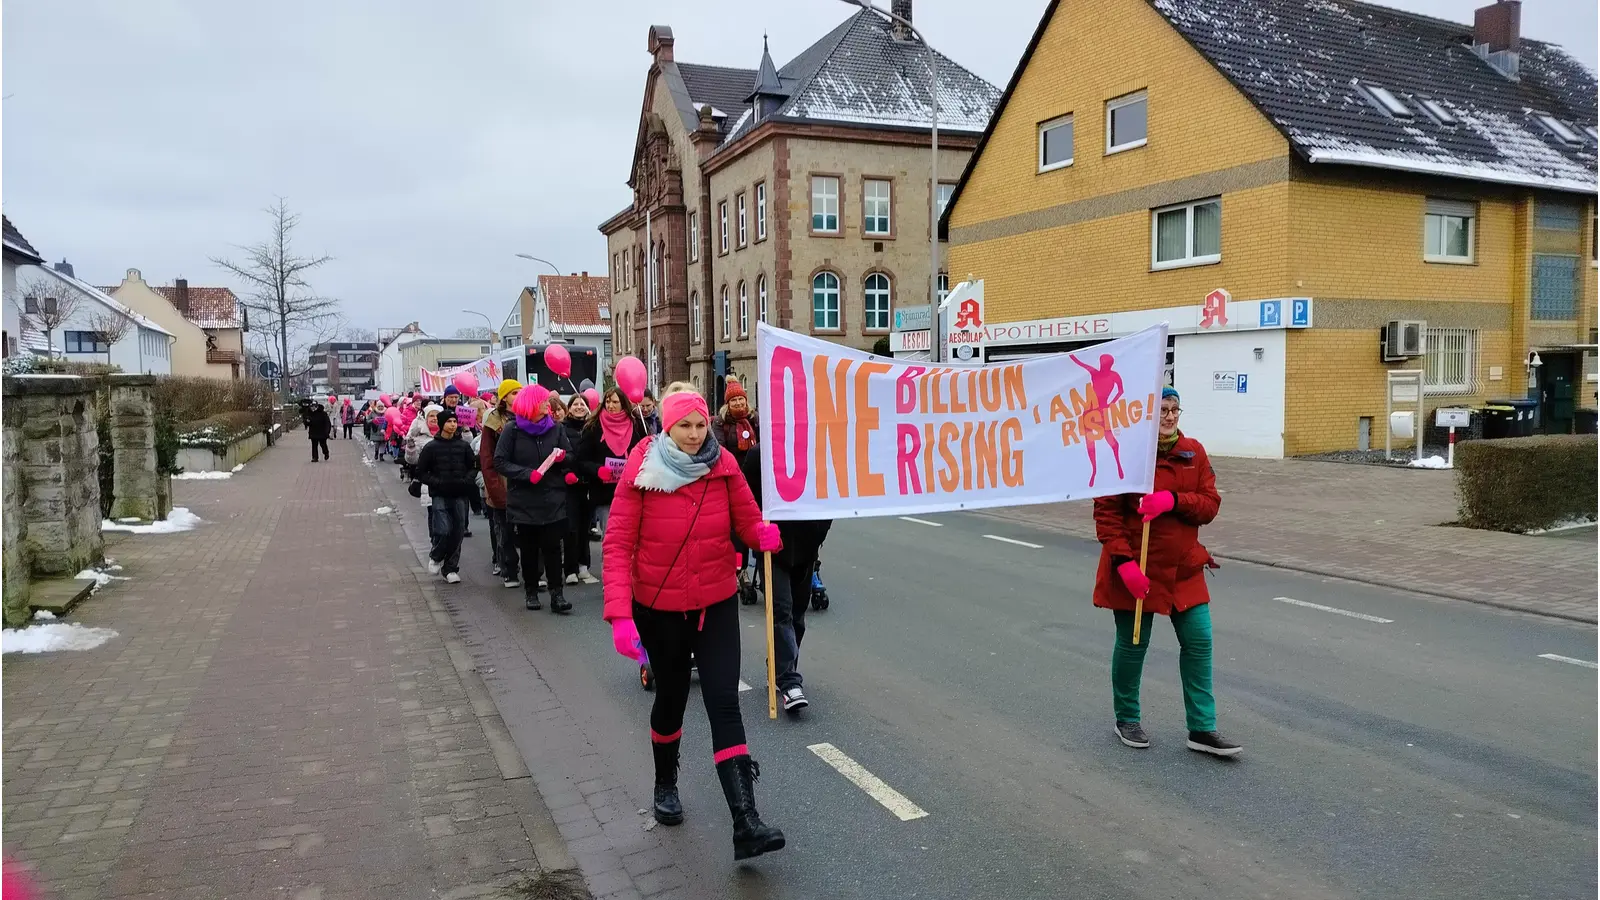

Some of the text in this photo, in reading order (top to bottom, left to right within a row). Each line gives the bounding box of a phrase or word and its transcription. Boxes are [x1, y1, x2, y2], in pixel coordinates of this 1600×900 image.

[1264, 303, 1275, 321] P
[1295, 301, 1304, 319] P
[902, 331, 929, 349] AESCUL
[949, 332, 983, 343] AESCULAP
[983, 319, 1110, 340] APOTHEKE
[896, 364, 1027, 414] BILLION
[1239, 375, 1246, 388] P
[1050, 383, 1100, 422] AM
[770, 345, 893, 502] ONE
[1062, 393, 1155, 447] RISING!
[896, 417, 1025, 495] RISING
